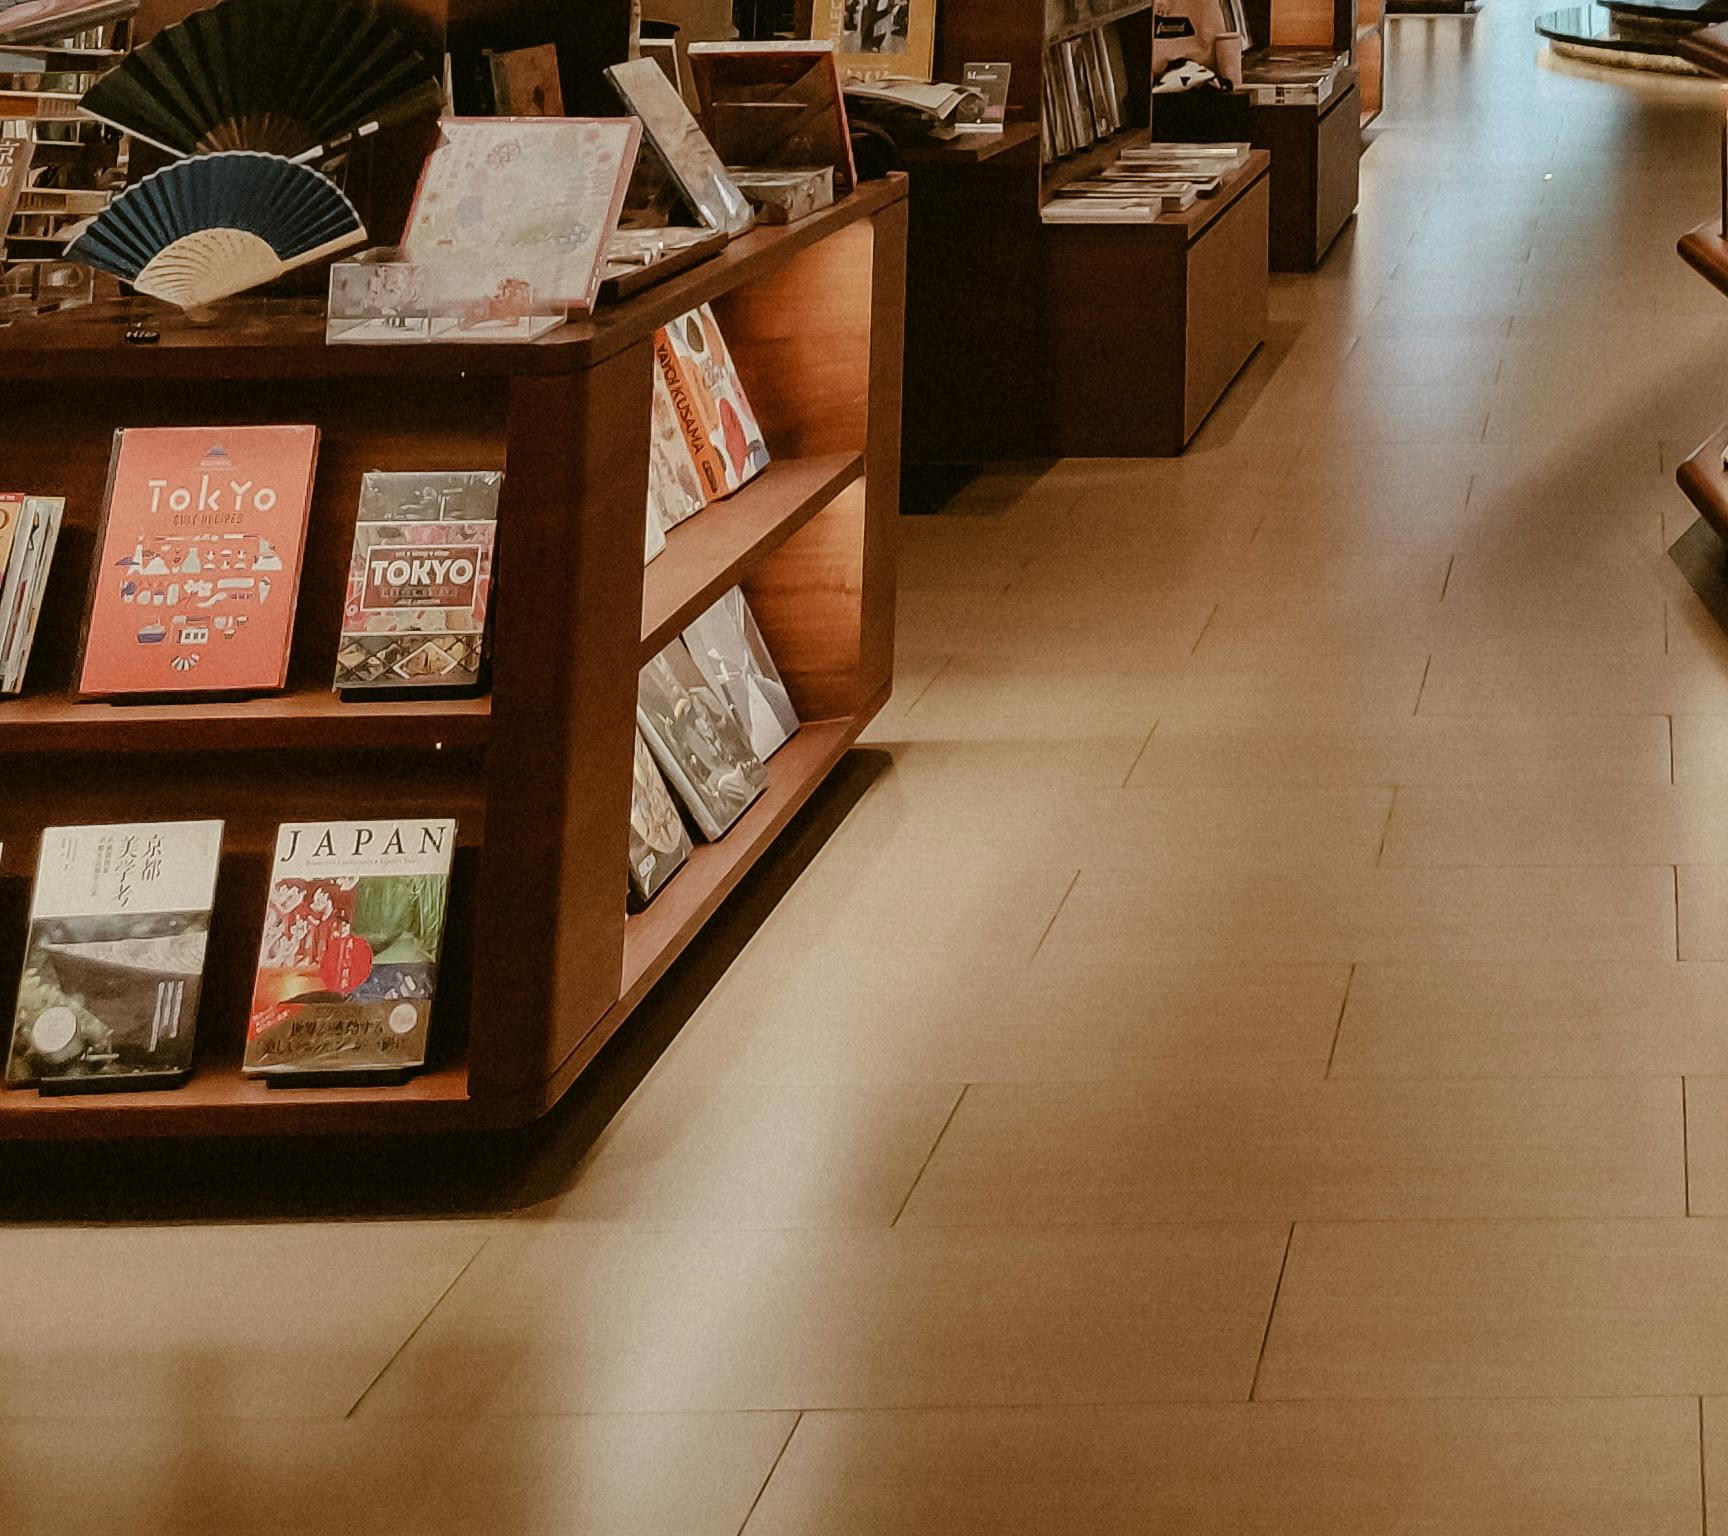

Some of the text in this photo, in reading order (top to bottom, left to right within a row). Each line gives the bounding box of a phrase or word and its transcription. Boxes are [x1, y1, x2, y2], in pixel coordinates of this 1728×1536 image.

[670, 384, 705, 457] KUSAMA
[370, 558, 475, 587] TOKYO
[142, 833, 165, 882] 京都
[280, 825, 447, 863] JAPAN
